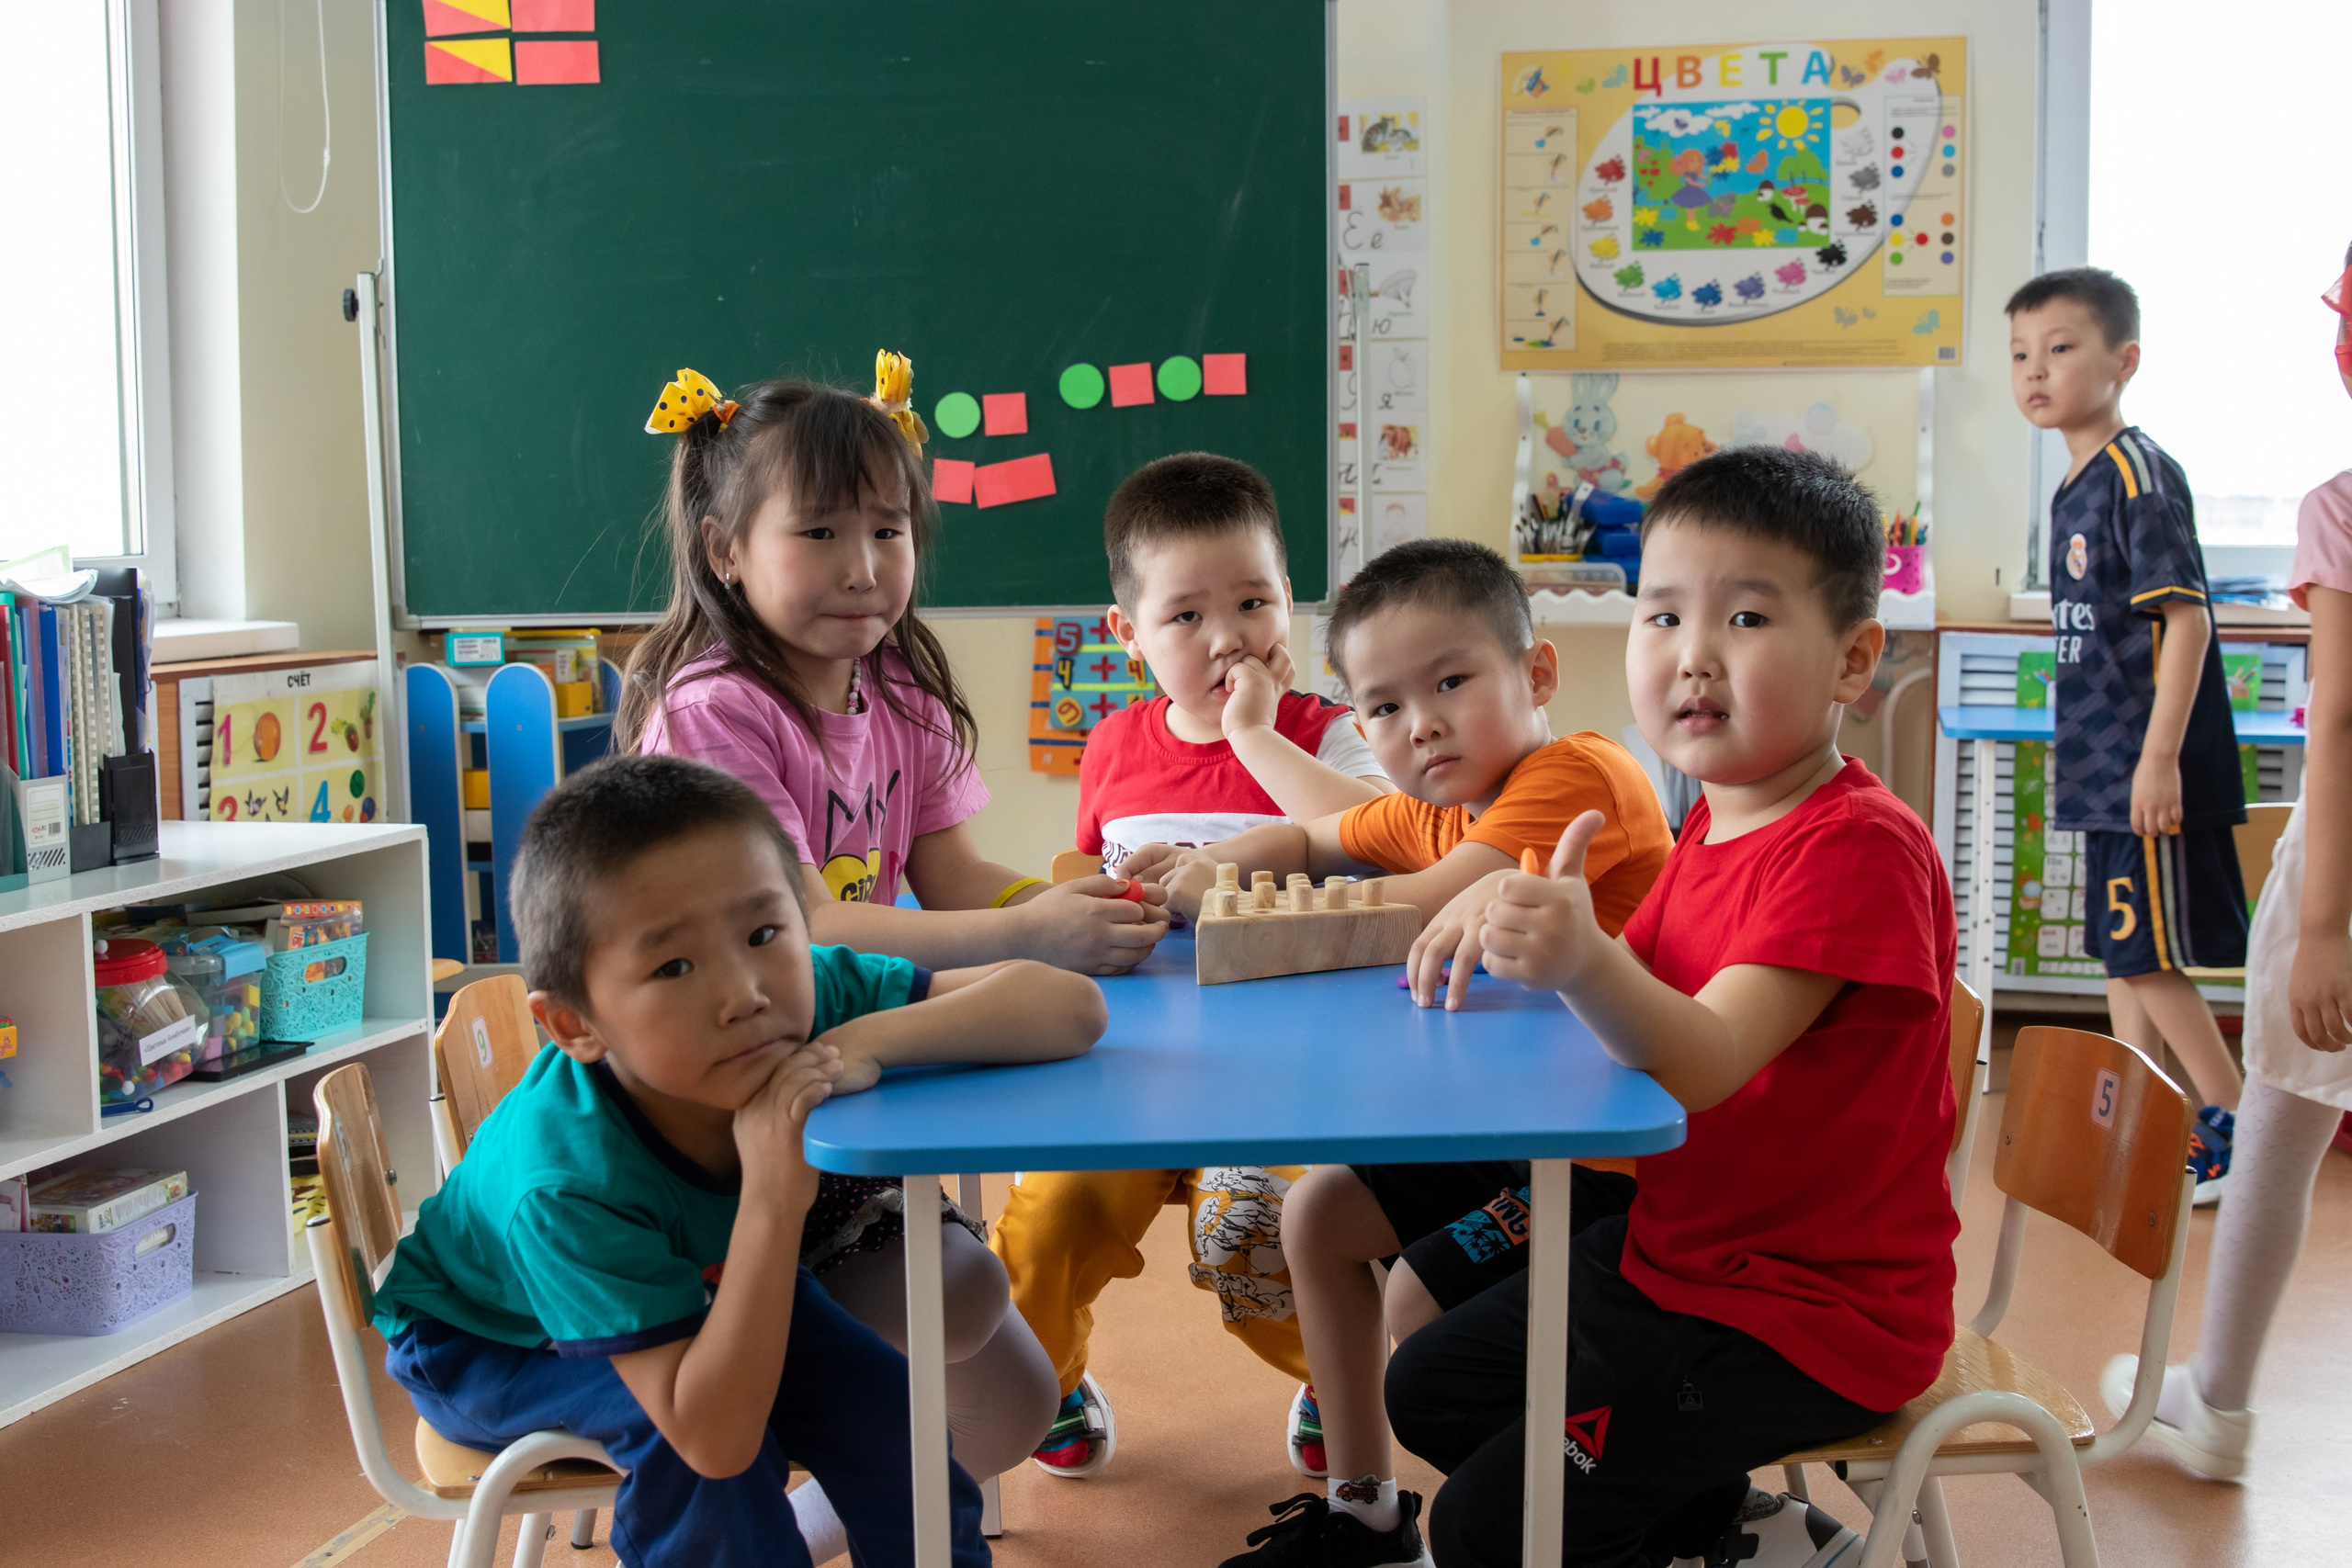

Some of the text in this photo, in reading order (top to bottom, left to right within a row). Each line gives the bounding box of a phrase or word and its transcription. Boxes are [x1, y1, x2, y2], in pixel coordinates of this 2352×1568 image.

[1634, 51, 1830, 97] ЦВЕТА
[1056, 622, 1082, 656] 5
[287, 671, 311, 687] СЧЁТ
[1057, 658, 1075, 690] 4
[218, 702, 328, 766] 1 2
[310, 780, 332, 823] 4
[2107, 876, 2137, 941] 5
[2098, 1078, 2113, 1117] 5
